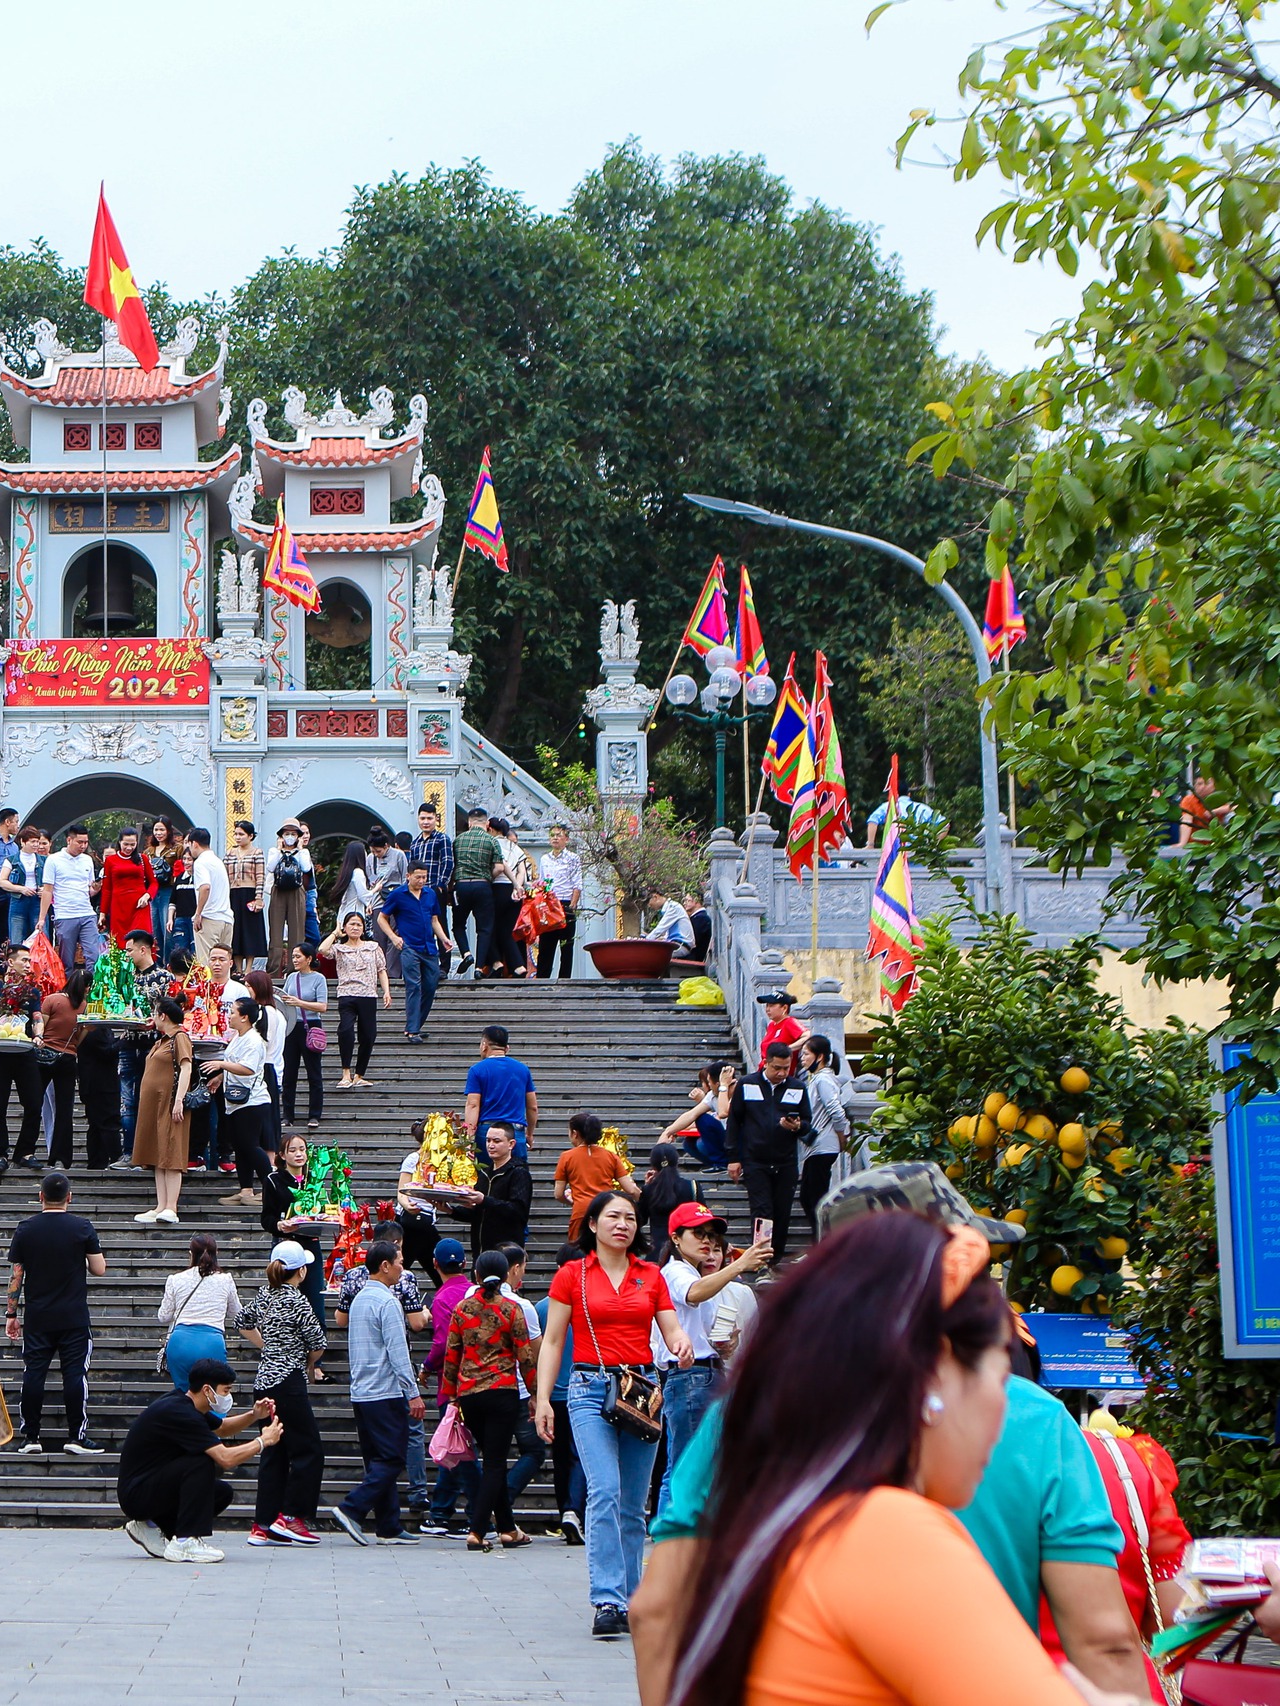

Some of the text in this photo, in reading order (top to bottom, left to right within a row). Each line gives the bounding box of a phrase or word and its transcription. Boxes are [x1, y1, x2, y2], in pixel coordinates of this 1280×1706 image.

[17, 647, 60, 673] Chúc
[62, 646, 111, 684] Mừng
[114, 646, 153, 673] Năm
[58, 685, 77, 699] Giáp
[108, 677, 179, 699] 2024
